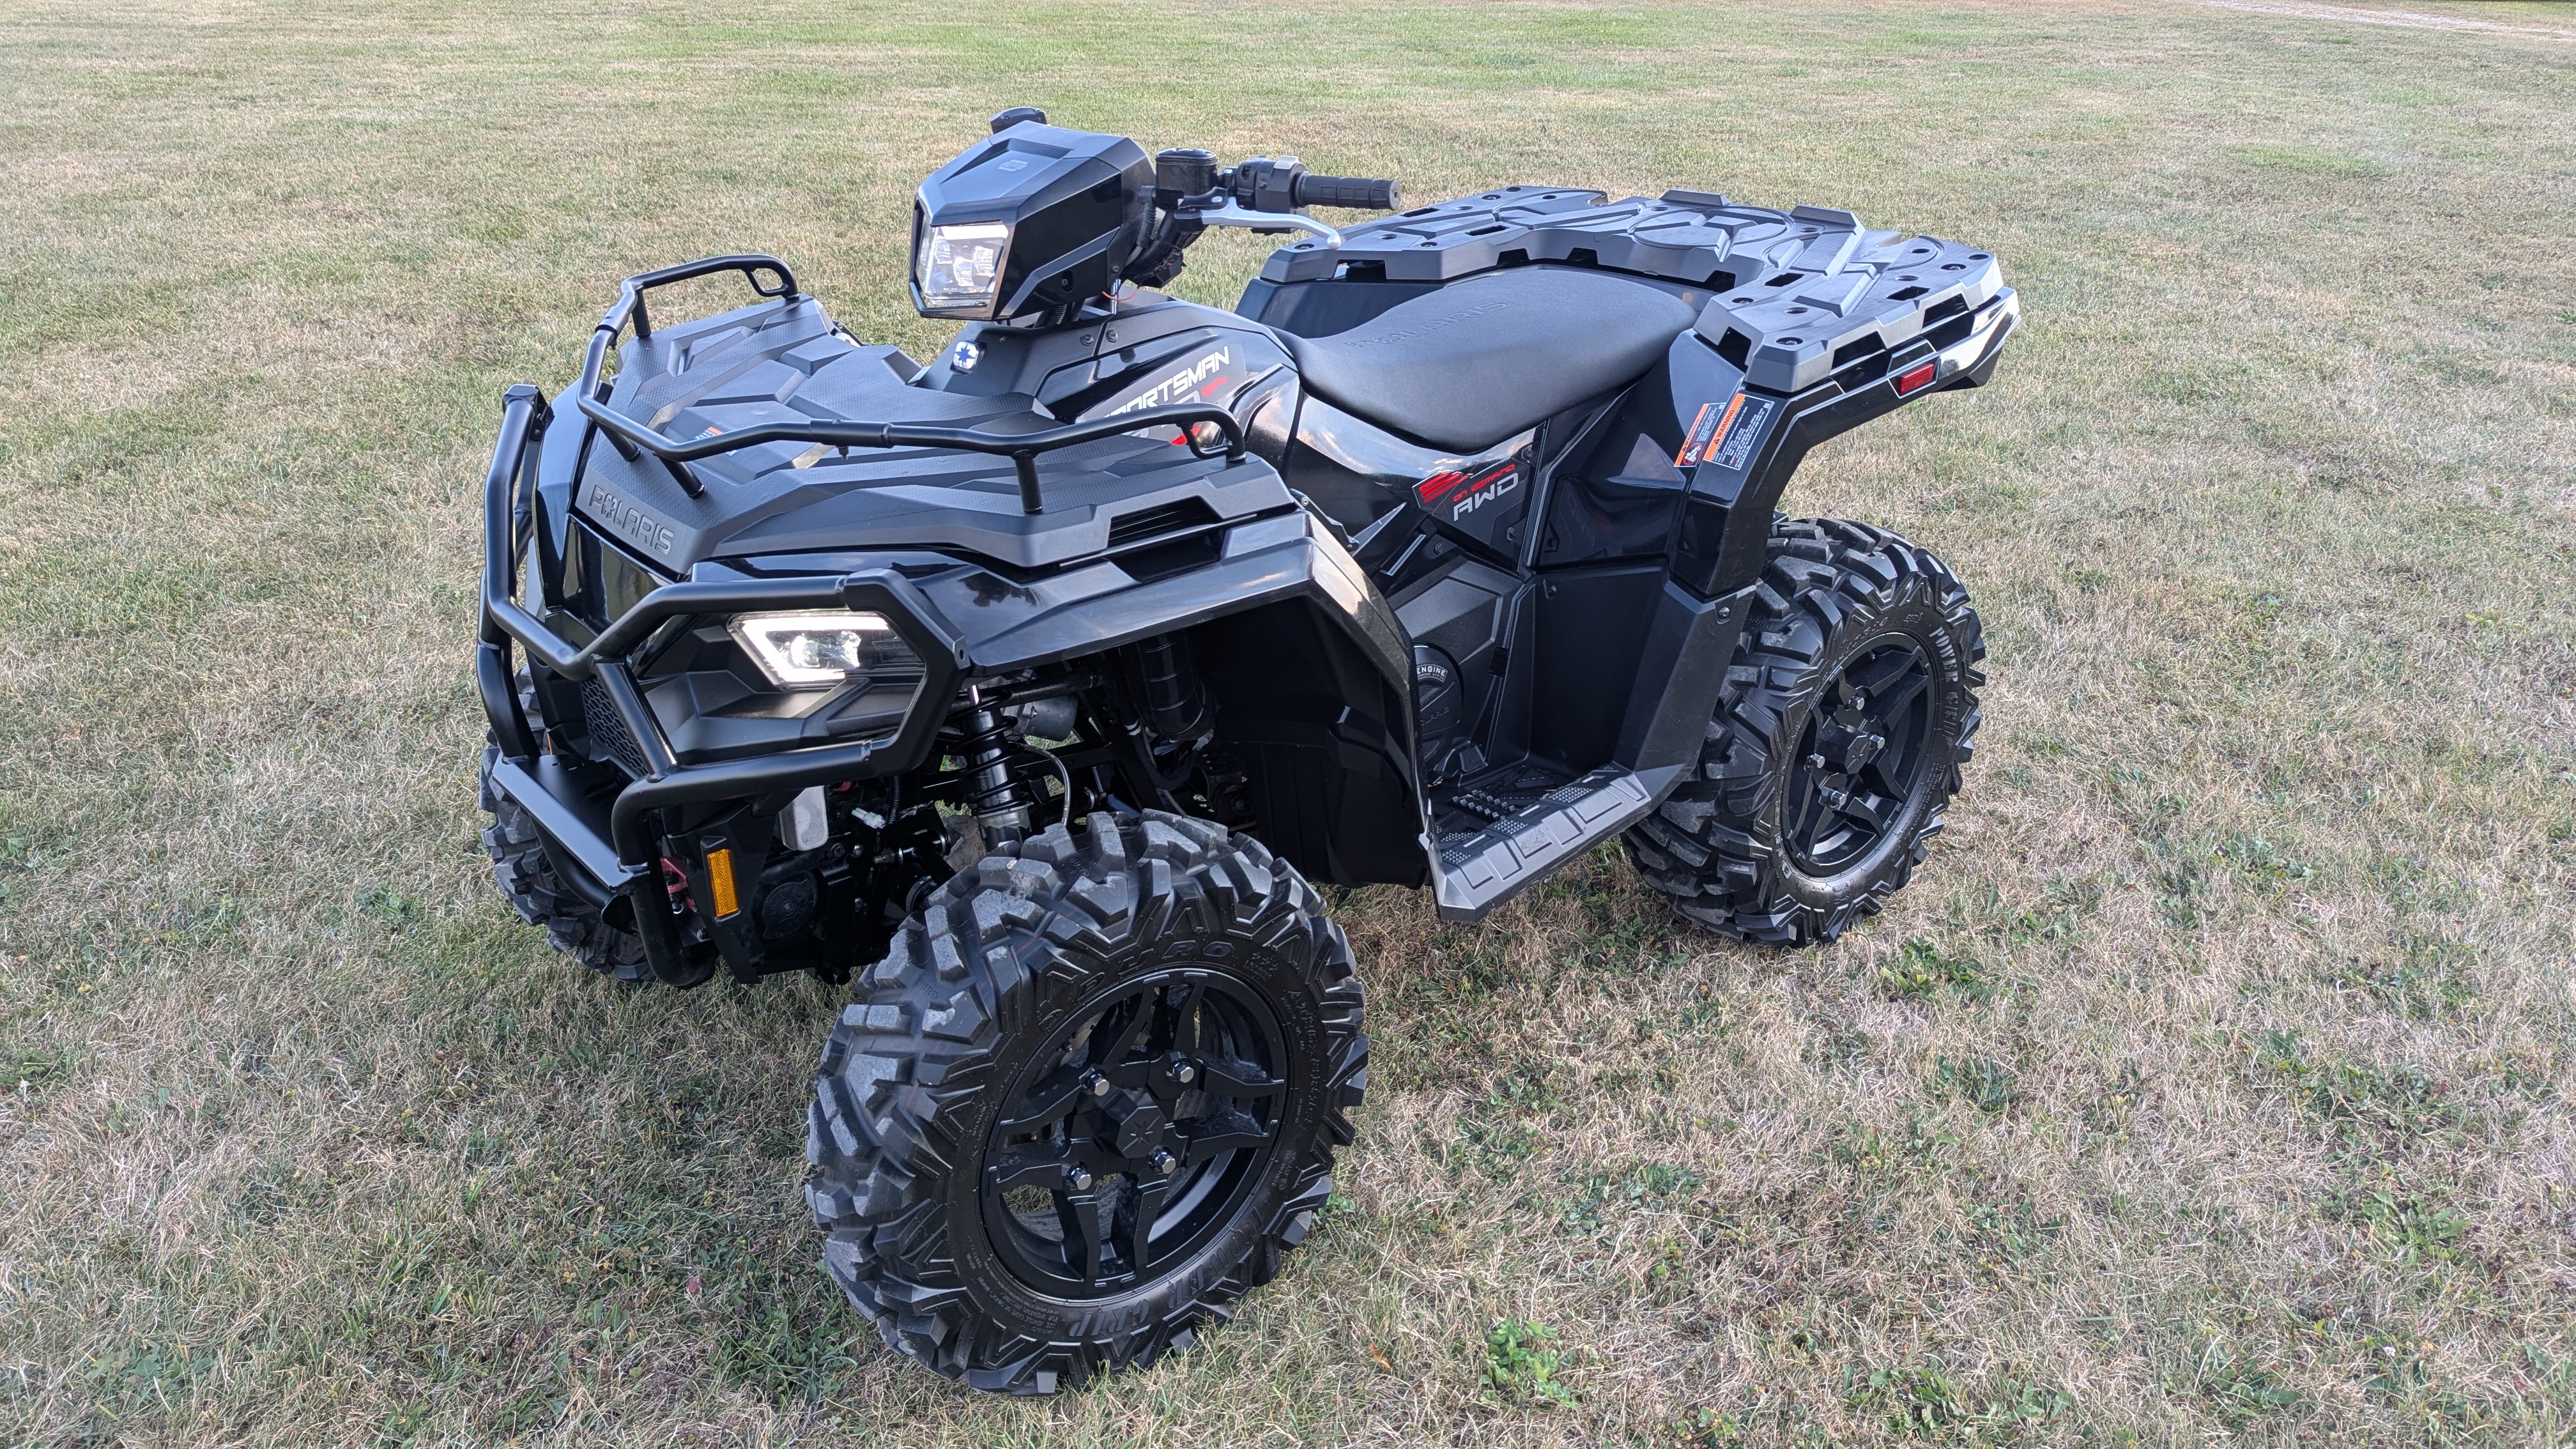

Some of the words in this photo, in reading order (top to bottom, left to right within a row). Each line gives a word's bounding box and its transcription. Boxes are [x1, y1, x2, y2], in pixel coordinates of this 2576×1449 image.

[1104, 346, 1230, 417] ORTSMAN
[1716, 410, 1735, 438] WARNING
[588, 484, 674, 555] POLARIS
[1453, 472, 1519, 522] AWD
[1416, 666, 1446, 677] ENGINE
[1928, 625, 1959, 683] POWER
[1069, 1298, 1150, 1337] GRIP
